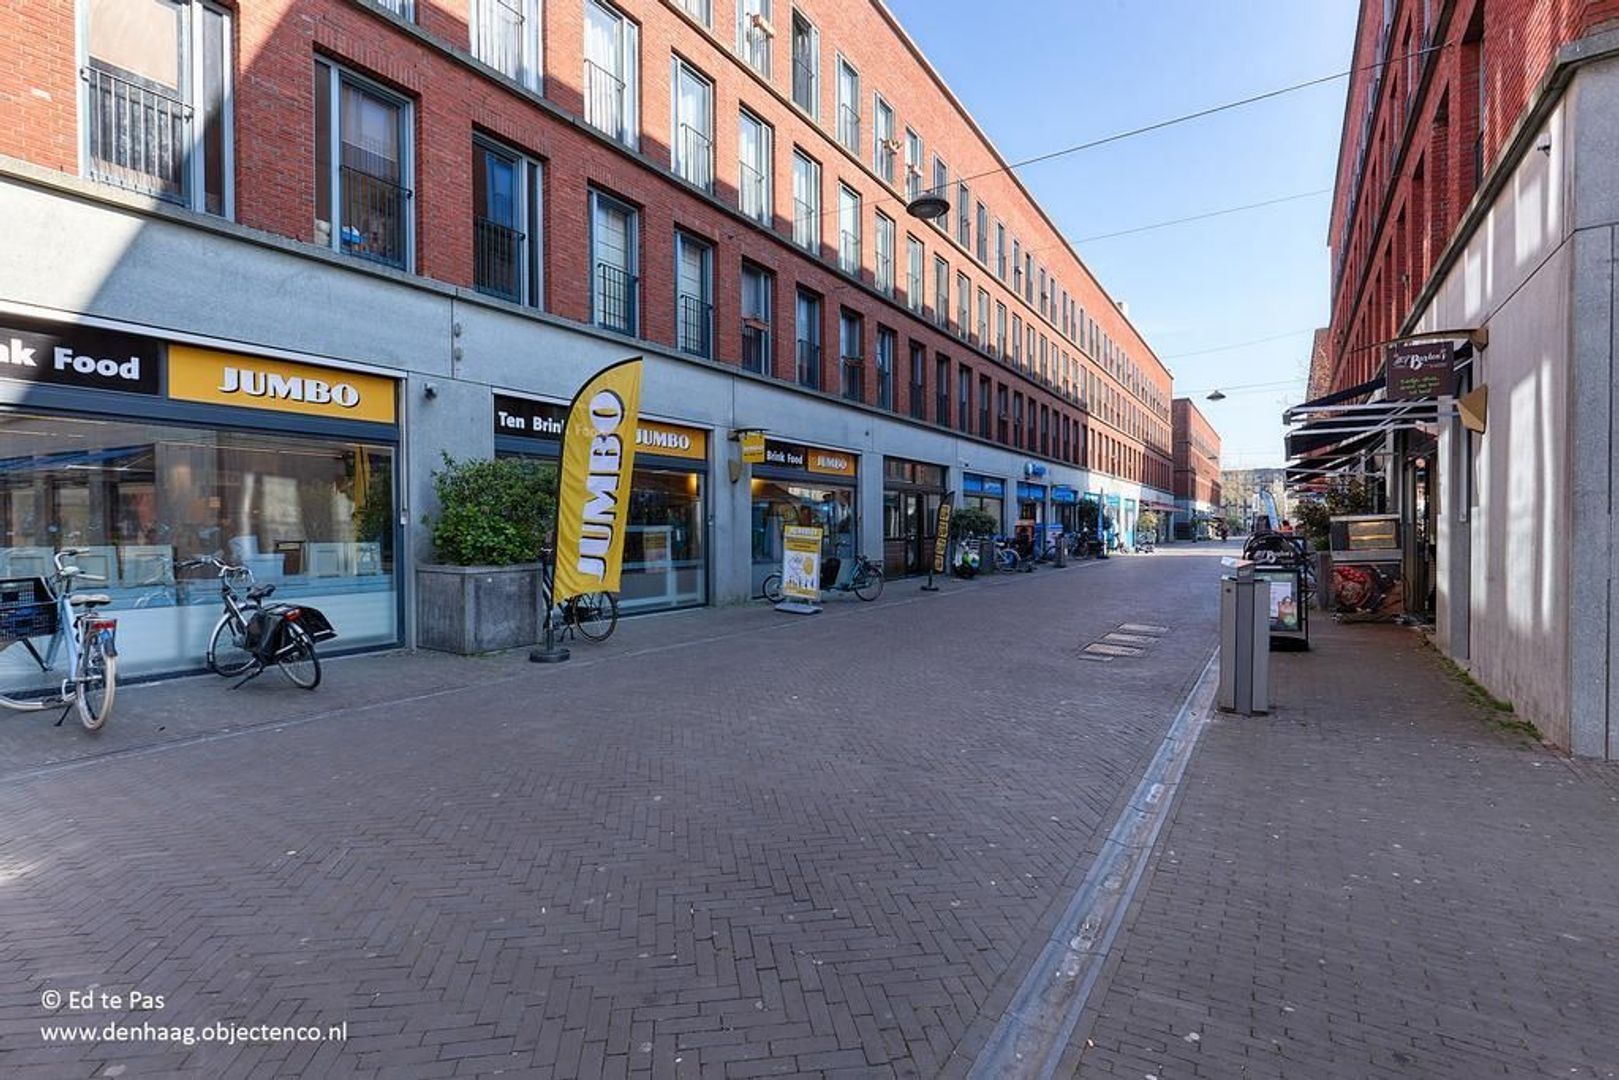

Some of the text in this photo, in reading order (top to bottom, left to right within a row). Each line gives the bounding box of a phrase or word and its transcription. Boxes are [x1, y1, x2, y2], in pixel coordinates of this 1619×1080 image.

[53, 346, 140, 380] Food
[217, 366, 360, 408] JUMBO
[498, 411, 526, 430] Ten
[634, 428, 692, 450] JUMBO
[766, 450, 804, 465] Brink Food
[817, 455, 848, 470] JUMBO
[577, 388, 625, 584] JUMBO
